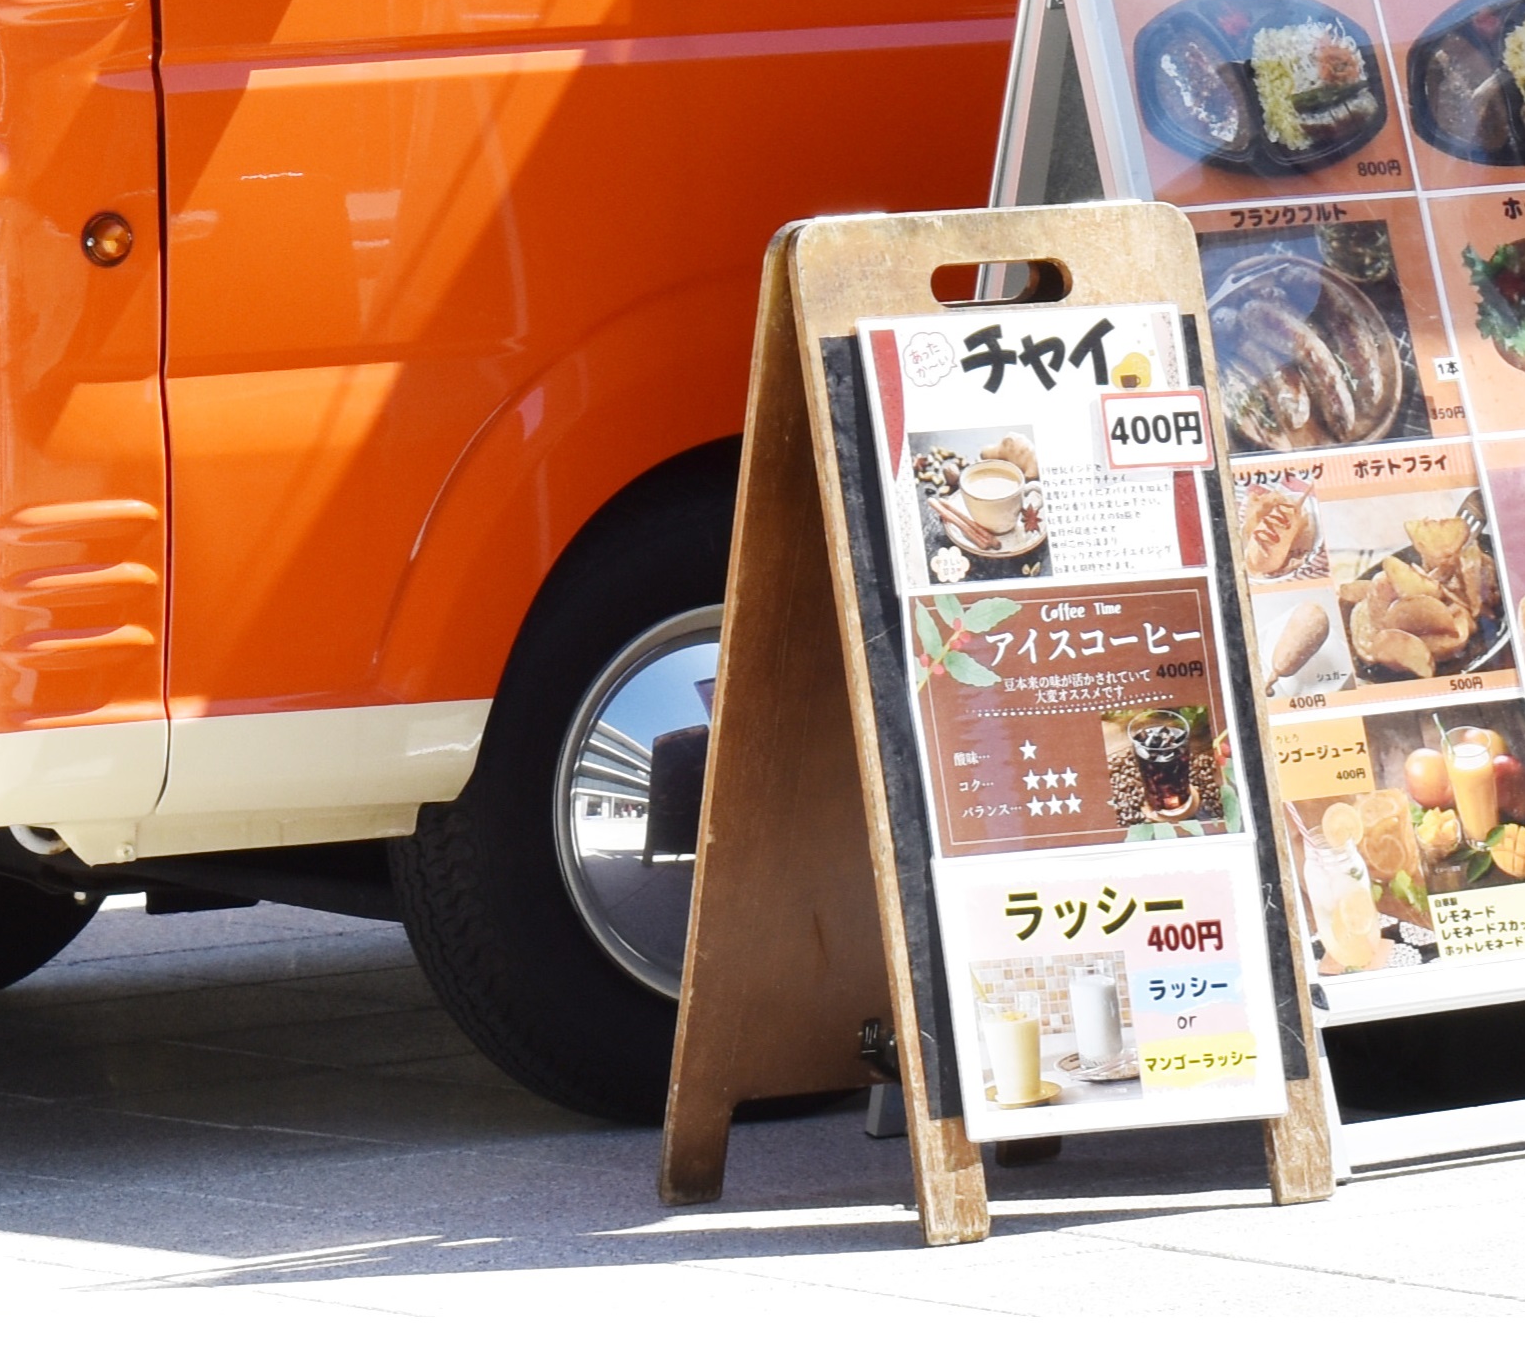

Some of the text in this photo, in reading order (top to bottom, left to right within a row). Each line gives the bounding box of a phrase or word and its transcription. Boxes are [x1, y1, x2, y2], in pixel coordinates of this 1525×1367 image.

[1357, 160, 1402, 178] 800円
[1230, 203, 1348, 227] フランクフルト
[960, 317, 1115, 394] チャイ
[1437, 361, 1459, 375] 1本
[1110, 411, 1203, 447] 400円
[1353, 454, 1448, 479] ポテトフライ
[1041, 602, 1122, 623] Coffee Time
[985, 622, 1201, 667] アイスコーヒー
[1003, 669, 1151, 693] 豆本来の味が活かされていて
[1156, 661, 1204, 680] 400円
[1034, 686, 1125, 704] 大変オススメです
[1449, 676, 1484, 693] 500円
[1289, 694, 1327, 709] 400円
[1278, 742, 1367, 764] ンゴージュース
[1336, 768, 1366, 780] 400円
[1005, 886, 1184, 941] ラッシー
[1437, 906, 1495, 924] レモネード
[1147, 919, 1224, 953] 400円
[1445, 936, 1523, 956] ホットレモネード
[1148, 976, 1228, 1001] ラッシー
[1177, 1014, 1197, 1029] or
[1145, 1051, 1257, 1072] マンゴーラッシー
